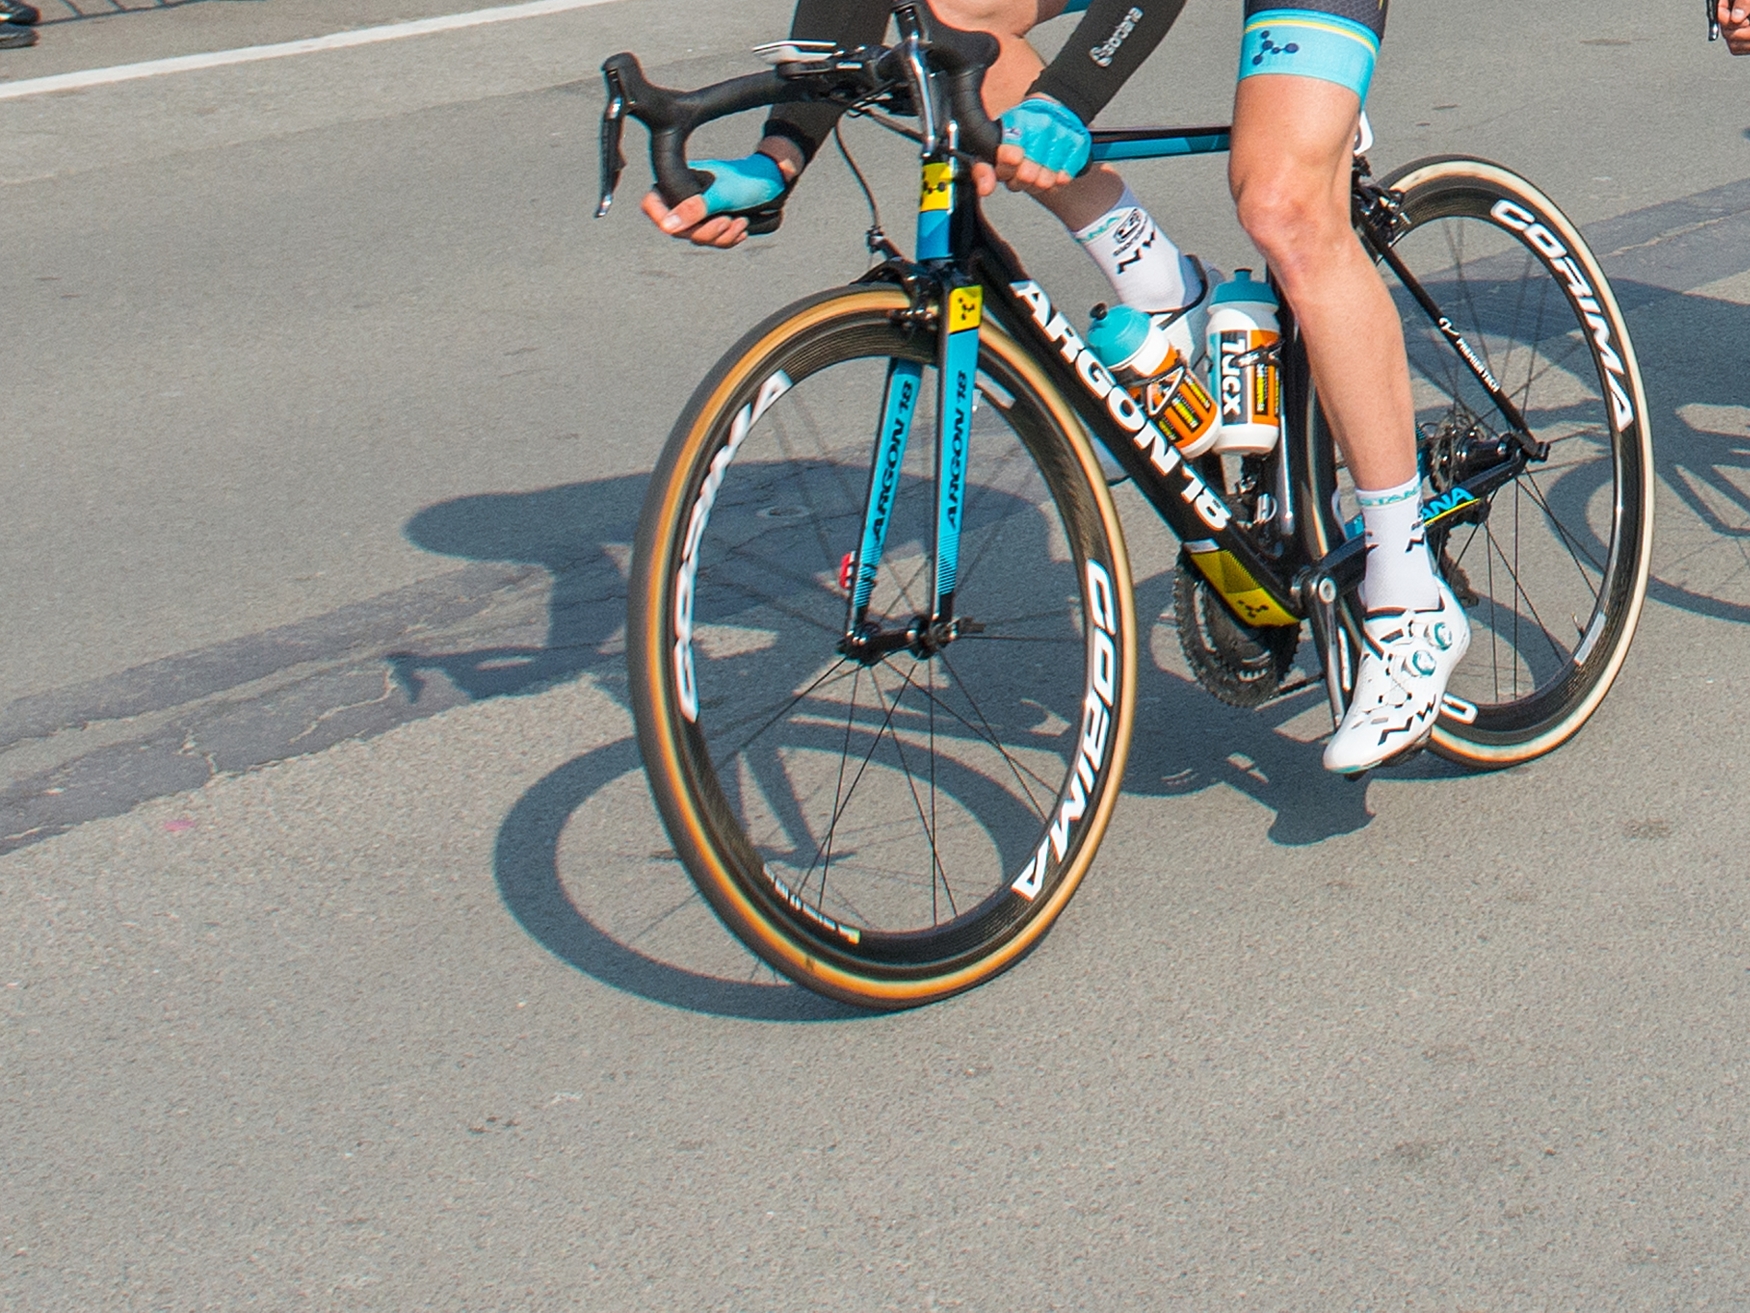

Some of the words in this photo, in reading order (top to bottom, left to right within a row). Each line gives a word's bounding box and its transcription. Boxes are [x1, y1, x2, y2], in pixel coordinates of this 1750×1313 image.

[955, 369, 968, 399] 18
[1014, 279, 1182, 476] ARGON
[1179, 467, 1232, 531] 18
[1491, 198, 1634, 433] CORIMA
[872, 418, 906, 541] ARGON
[899, 381, 913, 410] 18
[946, 409, 965, 531] ARGON
[1010, 558, 1117, 901] CORIMA
